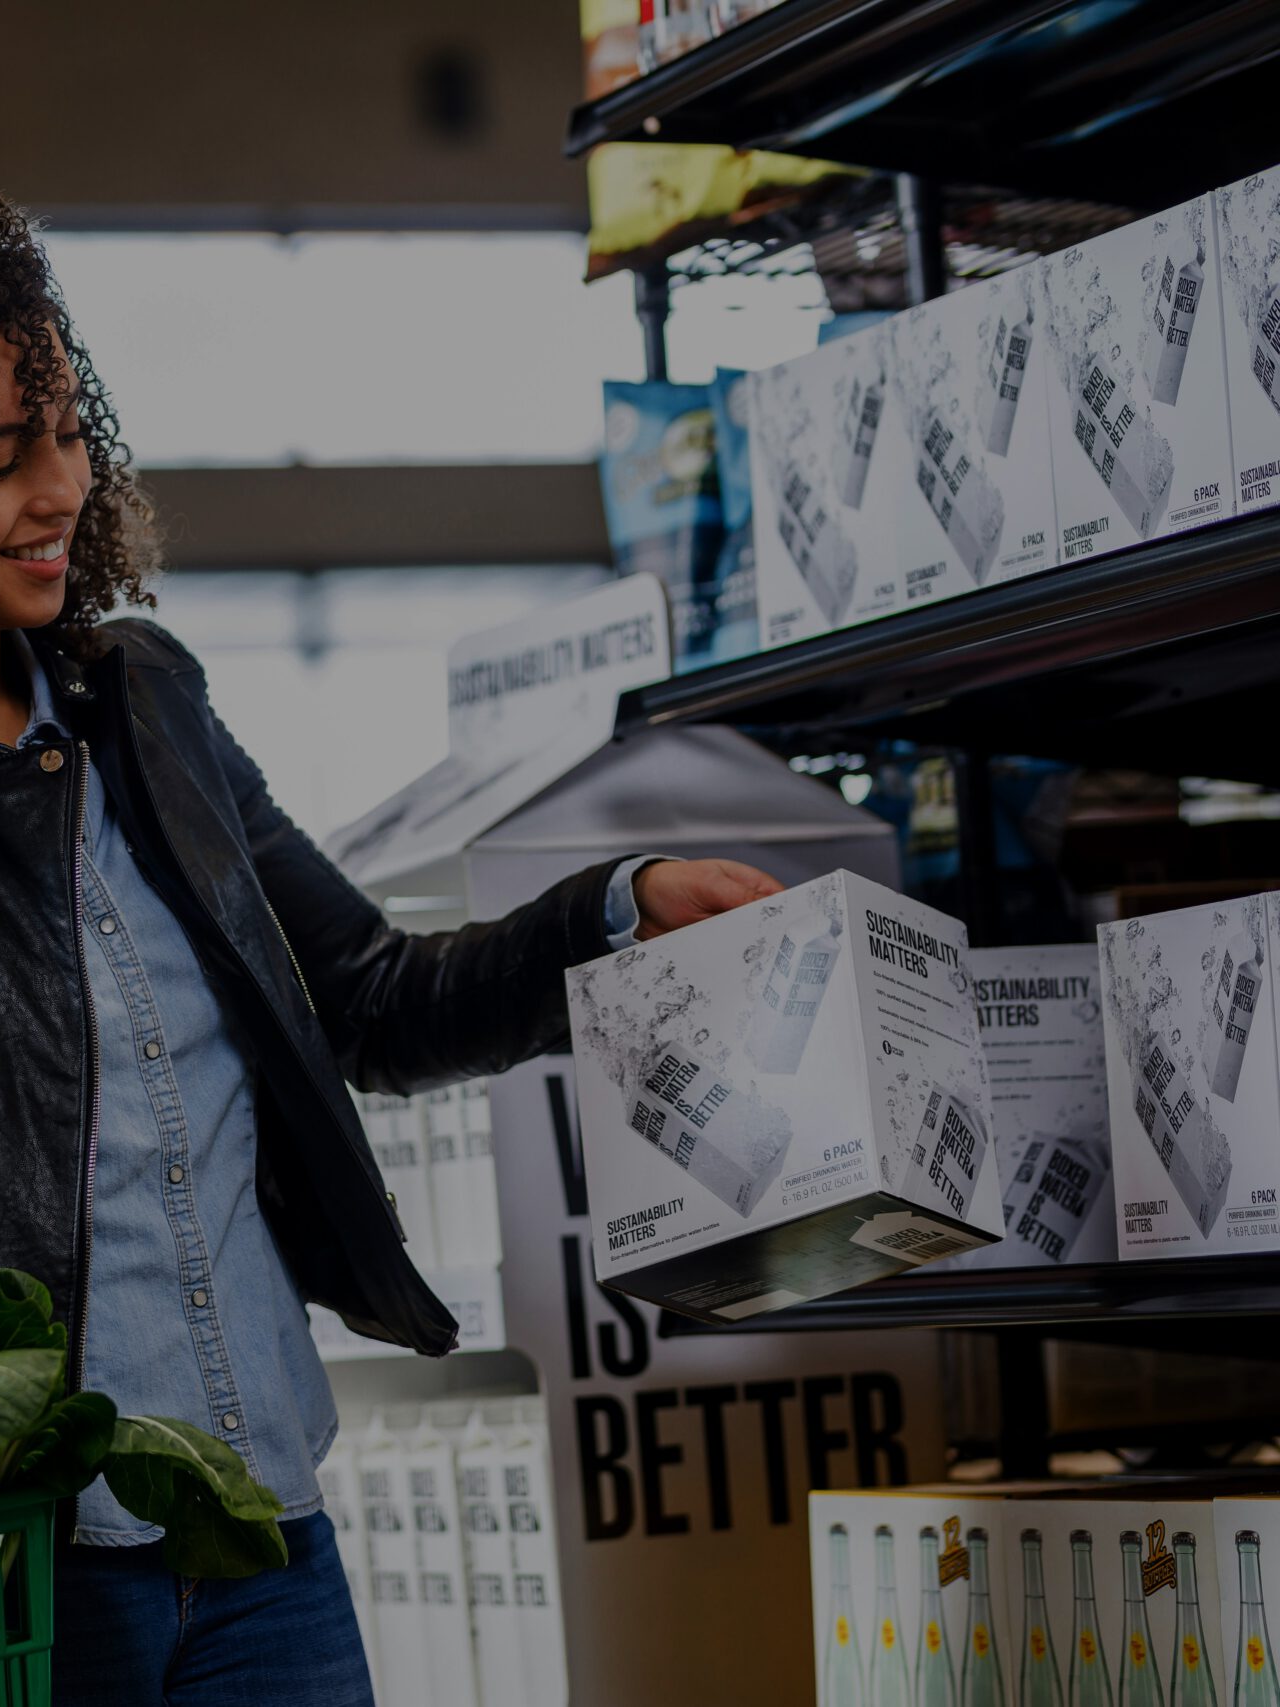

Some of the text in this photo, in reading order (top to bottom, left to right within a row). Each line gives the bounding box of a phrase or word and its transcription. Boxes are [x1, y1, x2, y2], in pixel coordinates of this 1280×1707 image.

[1176, 277, 1197, 298] BOXED
[1173, 292, 1195, 315] WATER
[1169, 309, 1178, 327] IS
[1082, 366, 1104, 406] BOXED
[1091, 378, 1115, 420] WATER
[1100, 414, 1113, 435] IS
[1193, 482, 1221, 501] 6 PACK
[1241, 482, 1271, 504] MATTERS
[1022, 531, 1045, 549] 6 PACK
[1063, 516, 1109, 544] SUSTAINABILITY
[1064, 538, 1094, 559] MATTERS
[865, 909, 959, 969] SUSTAINABILITY
[800, 951, 830, 968] BOXED
[869, 934, 929, 979] MATTERS
[795, 968, 827, 985] WATER
[975, 976, 1090, 1002] STAINABILITY
[1236, 973, 1256, 997] BOXED
[789, 983, 801, 999] IS
[1232, 988, 1254, 1015] WATER
[977, 1003, 1040, 1028] ATTERS
[1228, 1005, 1237, 1023] IS
[644, 1054, 681, 1095] BOXED
[1143, 1045, 1165, 1085] BOXED
[659, 1062, 698, 1105] WATER
[1151, 1059, 1174, 1101] WATER
[630, 1100, 651, 1135] BOXED
[673, 1098, 694, 1118] IS
[688, 1083, 732, 1130] BETTER.
[1160, 1096, 1172, 1118] IS
[645, 1105, 667, 1147] WATER
[945, 1104, 976, 1155] BOXED
[823, 1138, 864, 1162] 6 PACK
[934, 1140, 947, 1166] IS
[940, 1122, 972, 1176] WATER
[785, 1157, 862, 1188] PURIFIED DRINKING WATER
[1048, 1147, 1091, 1191] BOXED
[928, 1158, 964, 1220] BETTER.
[1038, 1170, 1081, 1216] WATER
[1251, 1188, 1277, 1204] 6 PACK
[607, 1197, 684, 1236] SUSTAINABILITY
[1027, 1191, 1046, 1217] IS
[1124, 1199, 1168, 1218] SUSTAINABILITY
[609, 1223, 657, 1251] MATTERS
[873, 1227, 923, 1247] BOXED
[1125, 1217, 1153, 1234] MATTERS
[886, 1232, 932, 1250] WATER
[575, 1371, 910, 1543] BETTER
[1145, 1519, 1167, 1564] 12
